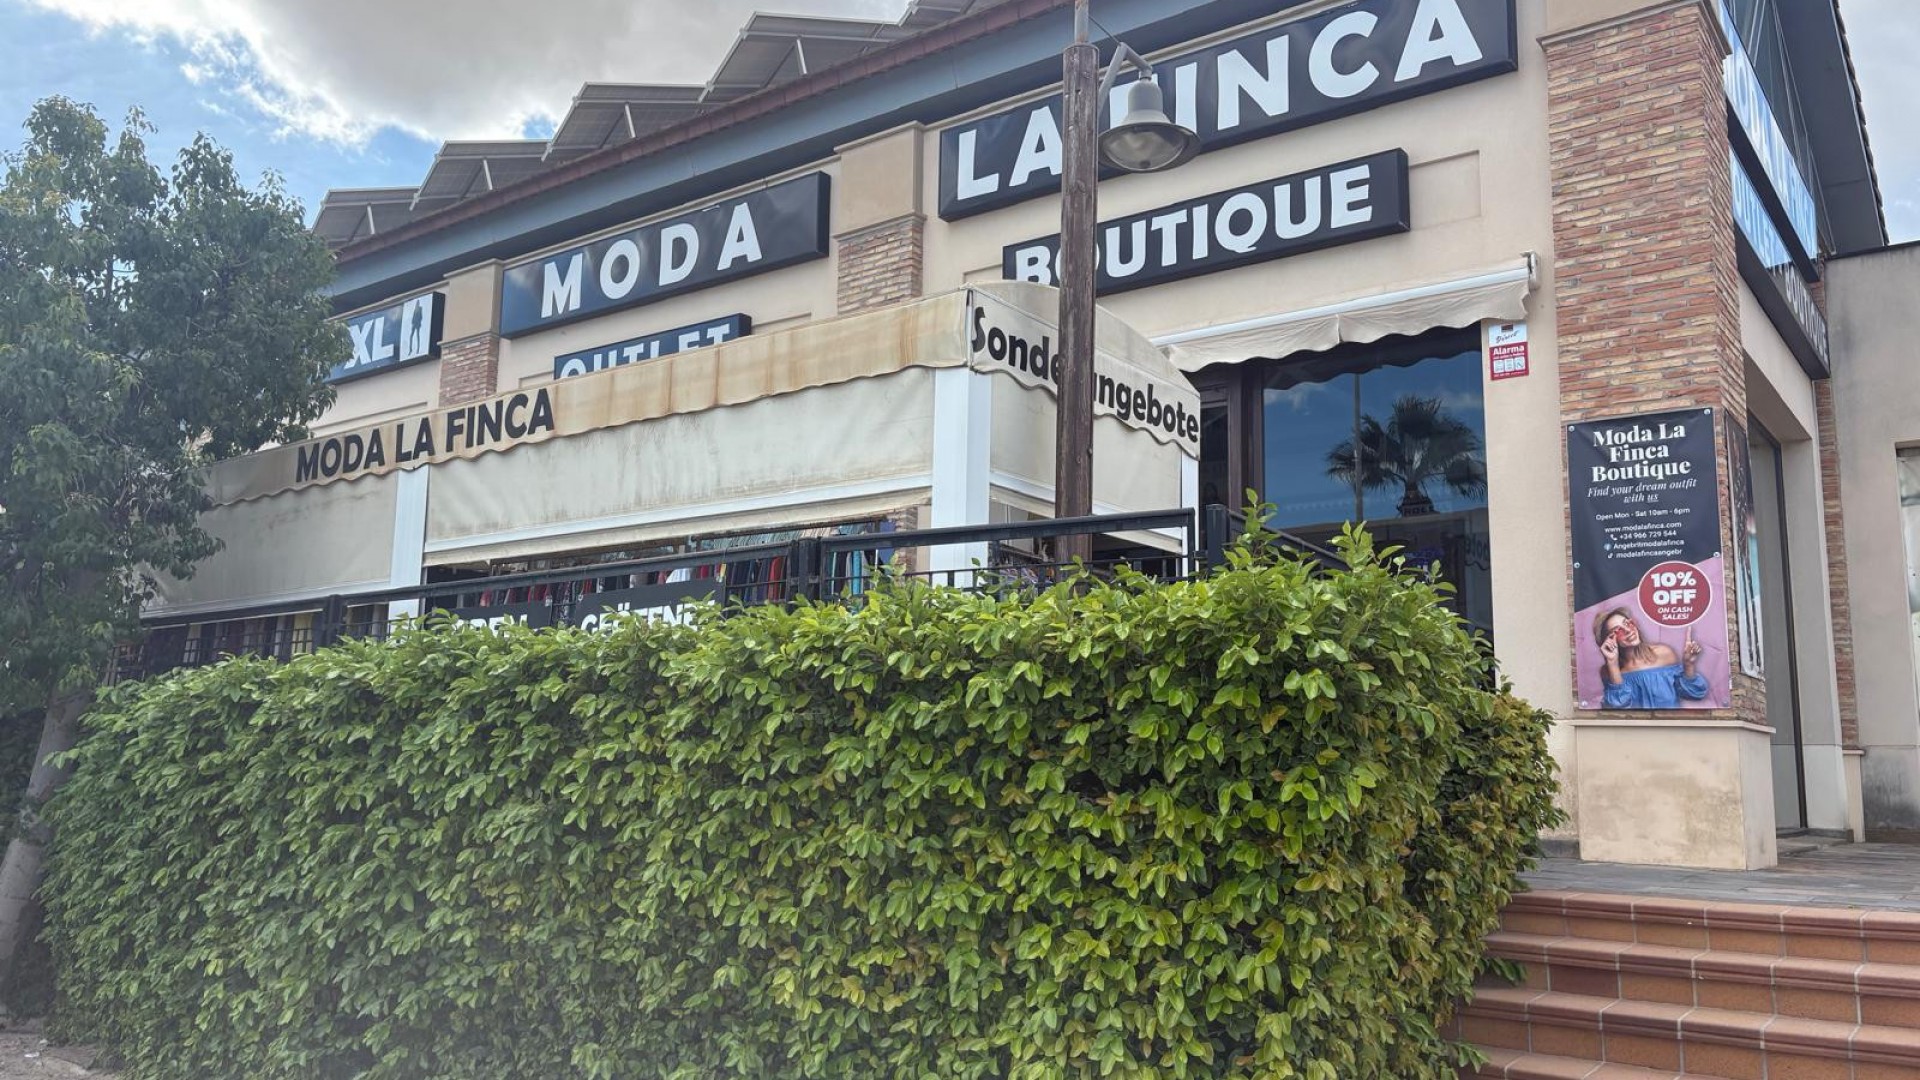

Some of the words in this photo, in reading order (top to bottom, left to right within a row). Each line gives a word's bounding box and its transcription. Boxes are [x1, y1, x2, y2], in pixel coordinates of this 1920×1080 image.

[957, 106, 1062, 200] LA
[1015, 165, 1373, 287] BUTIQUE
[541, 202, 762, 319] MODA
[343, 316, 395, 370] XL
[1493, 345, 1525, 355] Alarma
[972, 307, 1199, 443] Sondengebote
[296, 439, 385, 483] MODA
[395, 418, 436, 463] LA
[445, 388, 554, 453] FINCA
[1593, 425, 1652, 447] Moda
[1658, 423, 1686, 440] La
[1609, 444, 1669, 463] Finca
[1592, 460, 1691, 482] Boutique
[1587, 485, 1610, 497] Find
[1610, 486, 1634, 497] your
[1635, 482, 1667, 492] dream
[1669, 478, 1697, 490] outfit
[1623, 493, 1645, 503] with
[1647, 493, 1659, 503] us
[1673, 507, 1691, 516] 6pm
[1604, 522, 1682, 533] www.modalafinca.com
[1650, 571, 1697, 588] 10%
[1653, 589, 1697, 606] OFF
